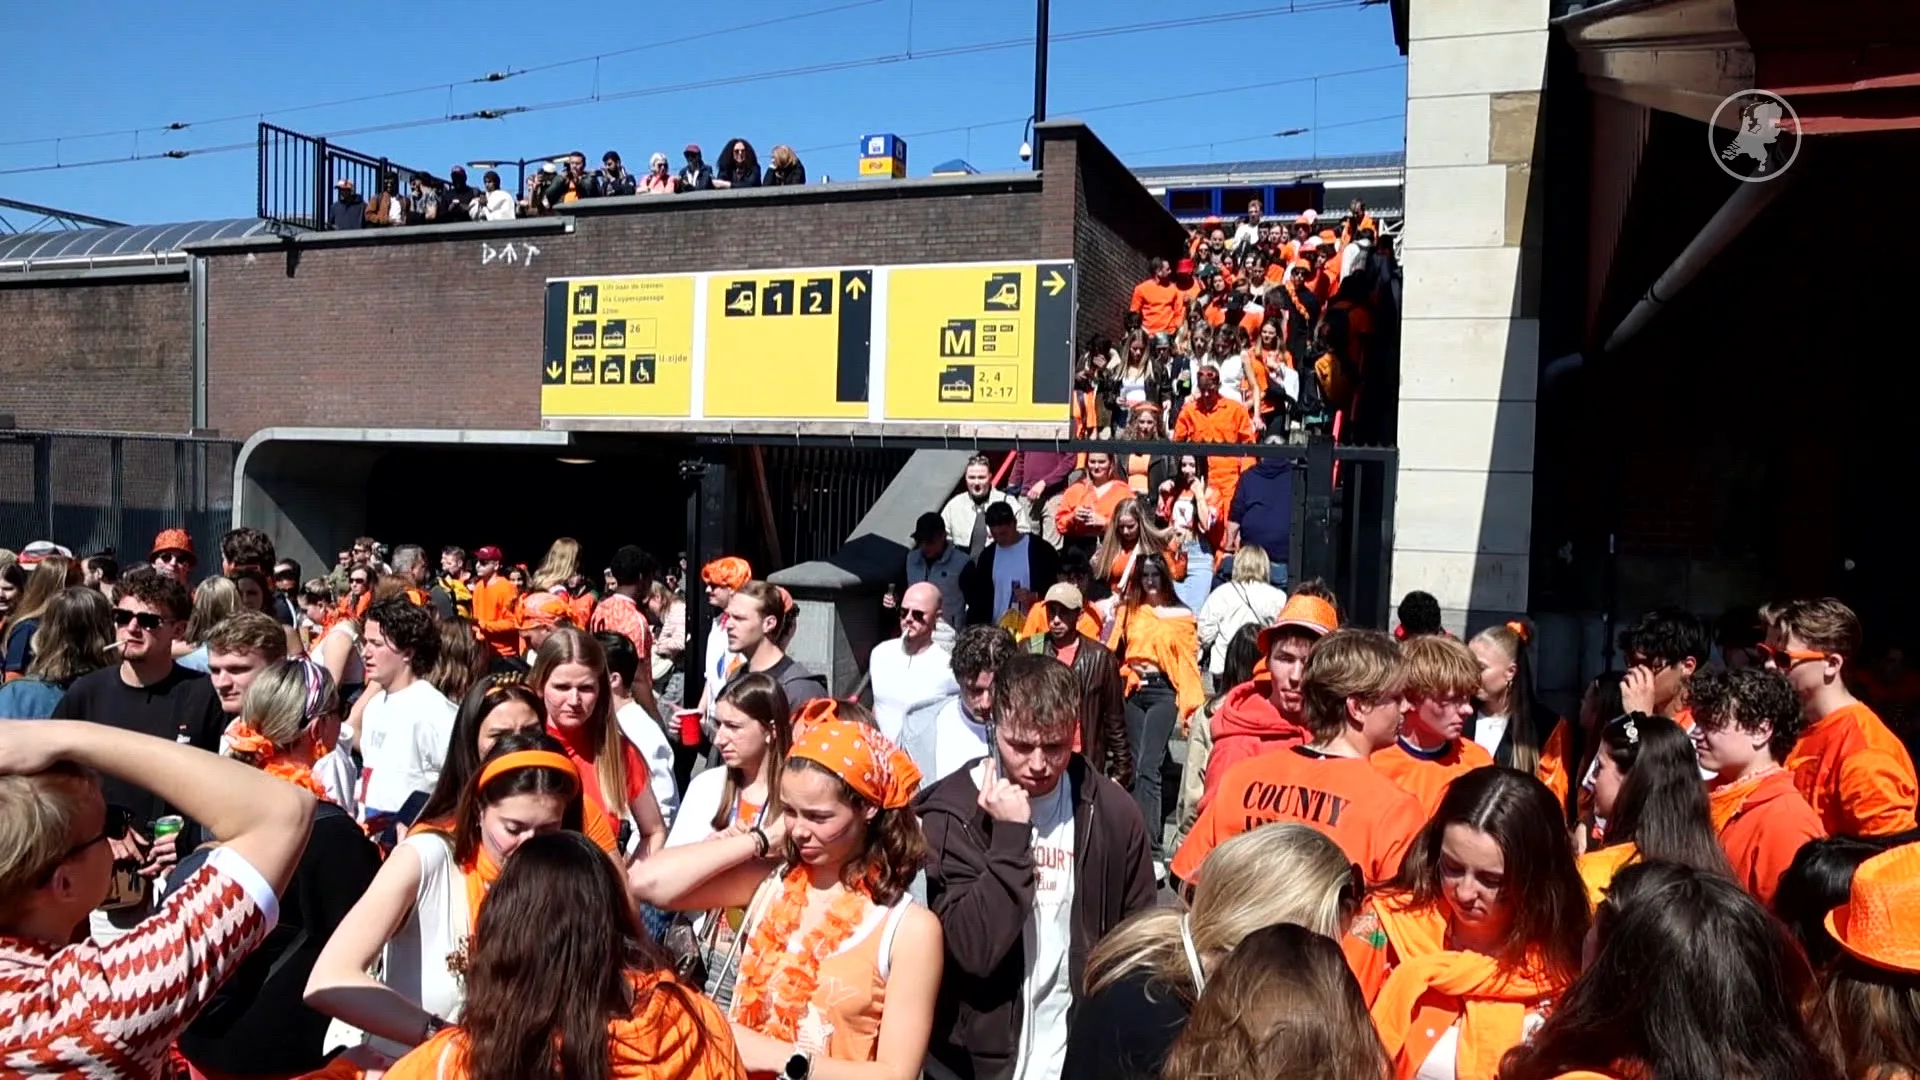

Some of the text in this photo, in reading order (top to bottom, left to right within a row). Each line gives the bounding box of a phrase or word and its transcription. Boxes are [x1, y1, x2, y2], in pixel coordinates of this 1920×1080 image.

[772, 291, 822, 313] 1 2
[629, 324, 641, 334] 26
[944, 329, 972, 355] M
[978, 371, 1001, 383] 2, 4
[979, 386, 1014, 398] 12-17
[1242, 780, 1352, 828] COUNTY
